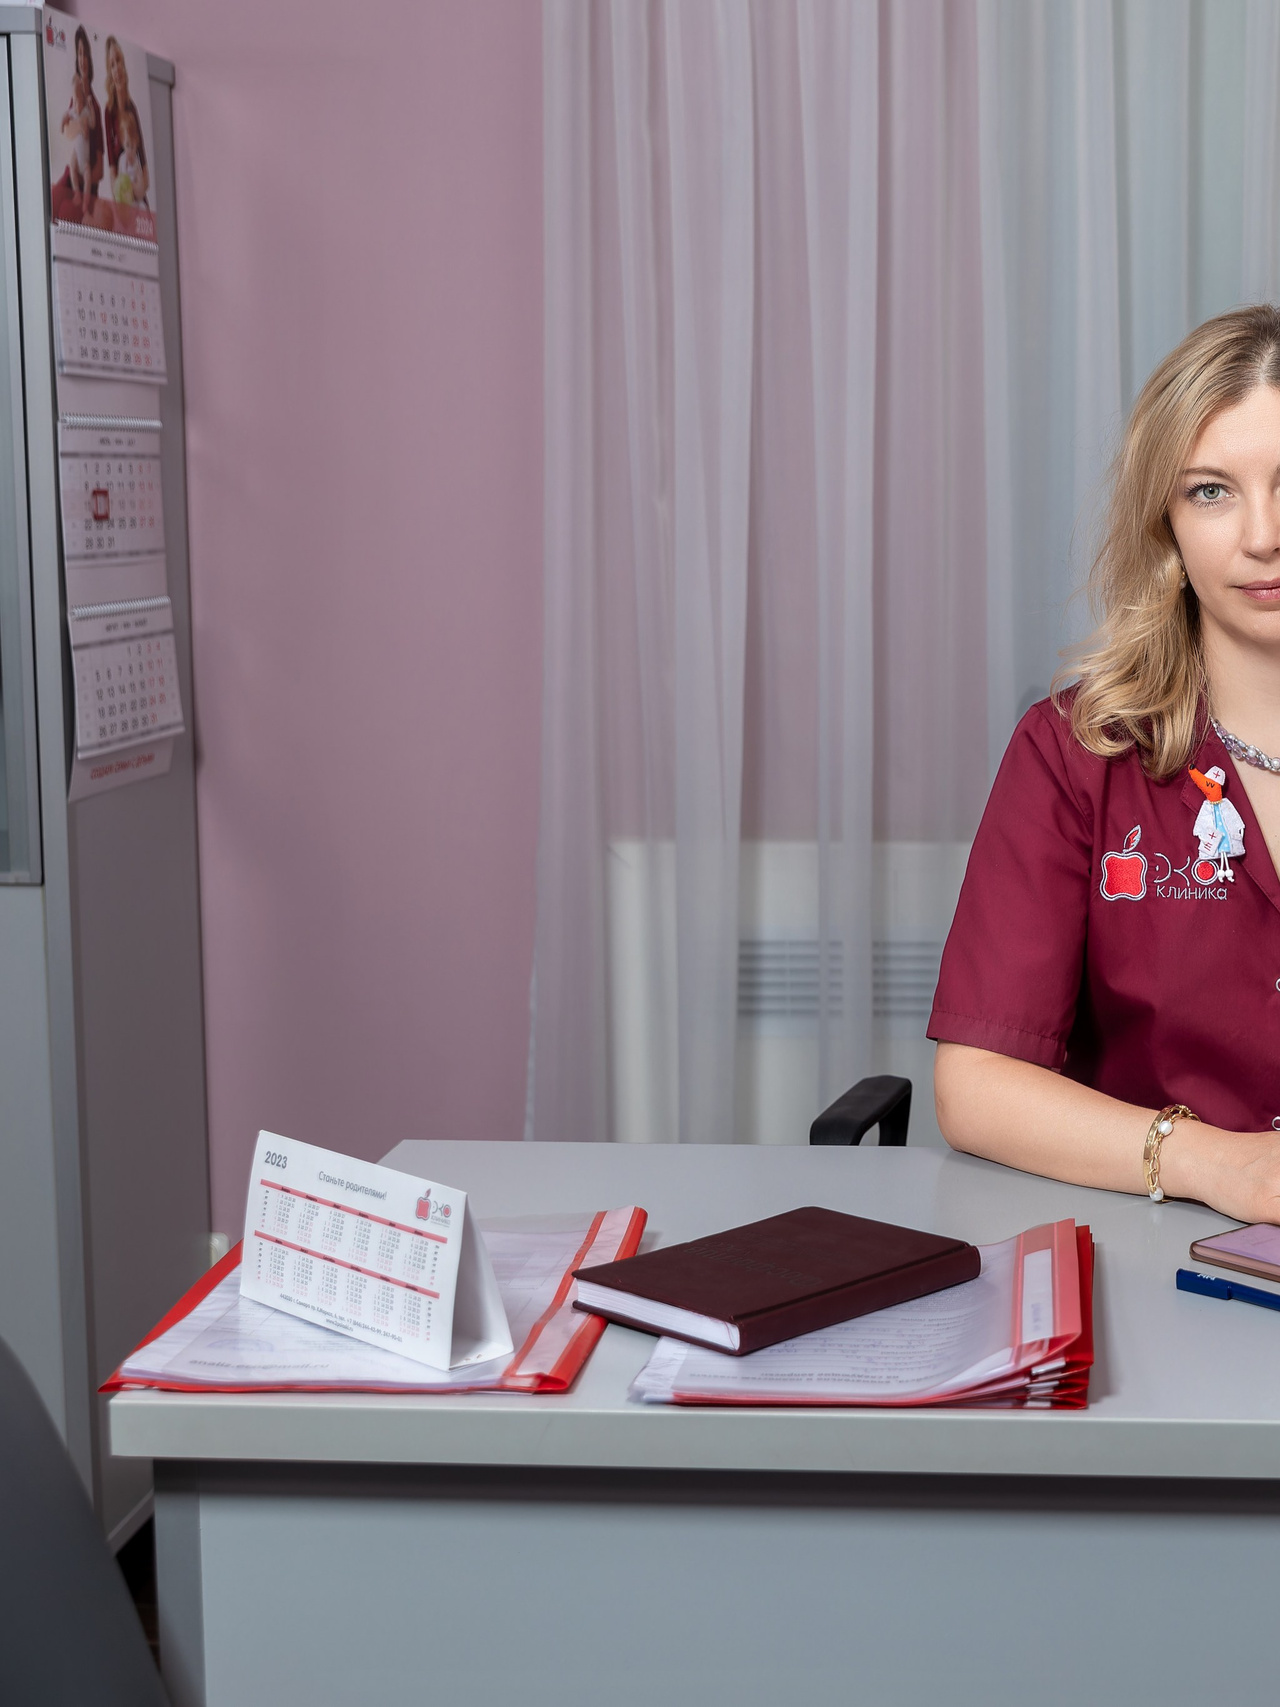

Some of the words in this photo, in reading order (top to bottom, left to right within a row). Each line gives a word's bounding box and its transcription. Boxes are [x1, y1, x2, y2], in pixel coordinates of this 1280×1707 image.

[264, 1150, 288, 1169] 2023
[318, 1170, 345, 1187] Станьте
[345, 1180, 388, 1200] родителями!
